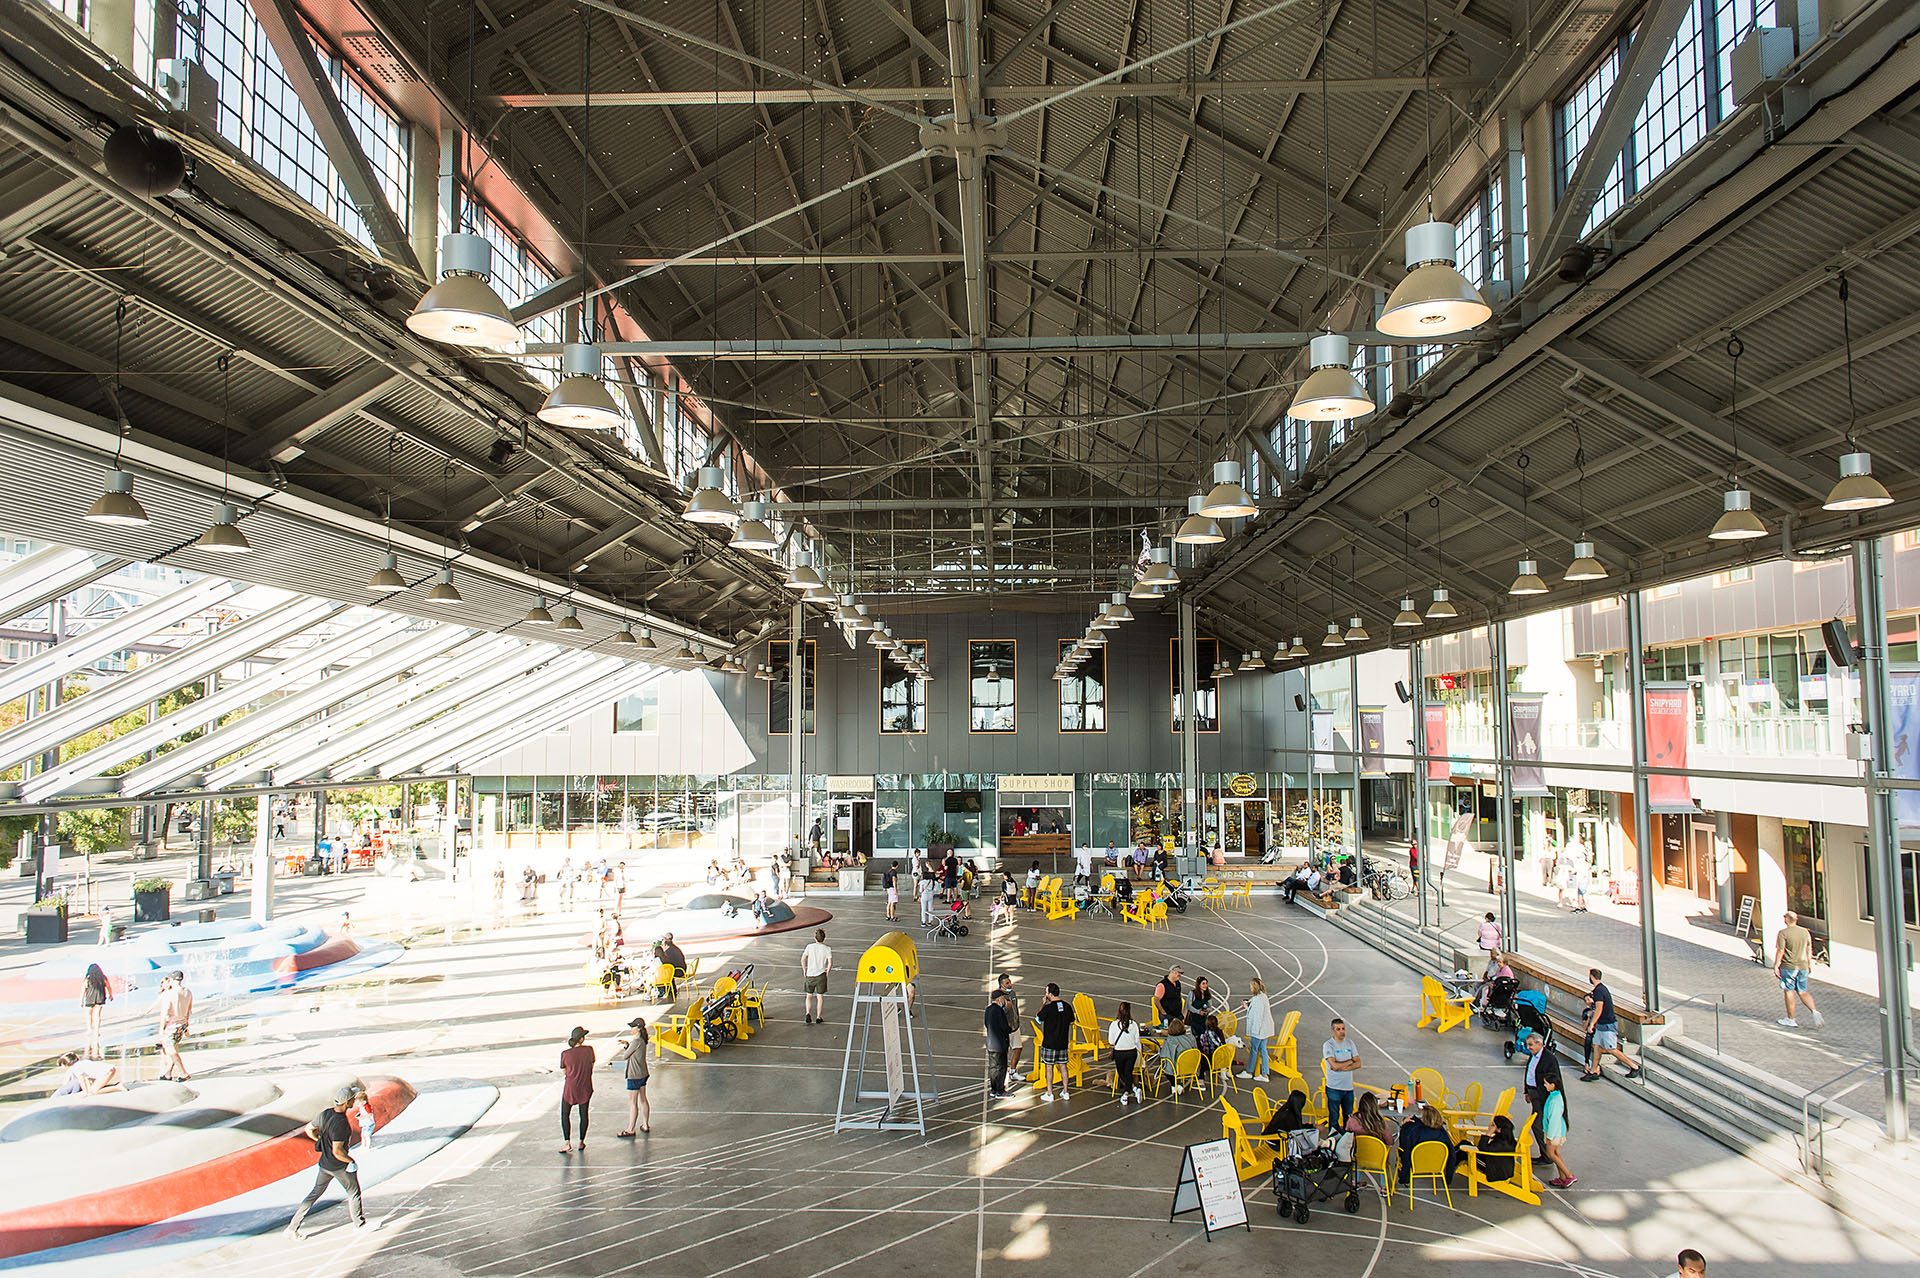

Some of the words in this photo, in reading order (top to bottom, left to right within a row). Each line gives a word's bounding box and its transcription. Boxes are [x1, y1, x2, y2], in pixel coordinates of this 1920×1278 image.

[829, 779, 871, 789] WASHROOMS
[1002, 779, 1039, 788] SUPPLY
[1044, 779, 1069, 788] SHOP
[1214, 1151, 1231, 1160] SAFETY
